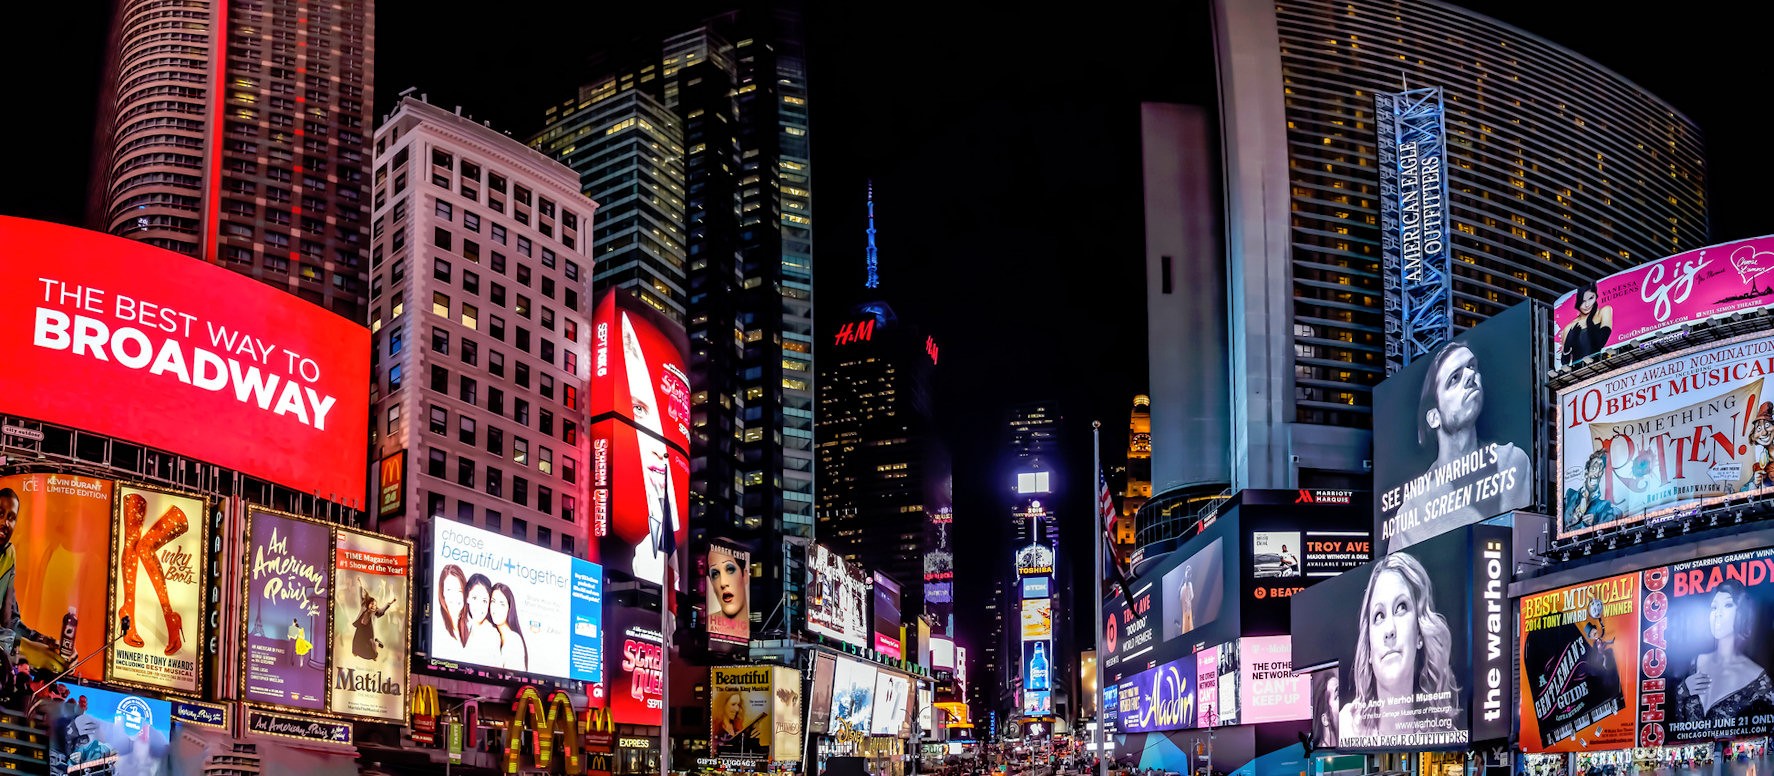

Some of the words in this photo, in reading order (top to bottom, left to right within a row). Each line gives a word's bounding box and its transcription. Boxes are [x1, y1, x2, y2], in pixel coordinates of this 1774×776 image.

[1400, 141, 1418, 189] EAGLE
[1421, 156, 1442, 255] OUTFITTERS
[1402, 191, 1421, 282] AMERICAN
[1602, 281, 1637, 296] VANESSA
[1602, 287, 1639, 304] HUDGENS
[1641, 251, 1714, 322] Gigi
[1716, 304, 1735, 312] SIMON
[1737, 300, 1762, 308] THEATRE
[38, 278, 105, 314] THE
[116, 295, 198, 338] BEST
[207, 321, 276, 364] WAY
[283, 349, 320, 383] TO
[835, 319, 875, 345] H&M
[34, 306, 337, 432] BROADWAY
[1675, 366, 1712, 378] INCLUDING
[1568, 388, 1603, 429] 10
[1606, 374, 1638, 394] TONY
[1640, 360, 1685, 384] AWARD
[1606, 384, 1662, 416] BEST
[1612, 395, 1736, 438] SOMETHING
[594, 438, 608, 486] SCREAM
[22, 480, 40, 492] ICE
[47, 478, 70, 486] KEVIN
[71, 480, 103, 491] DURANT
[1382, 487, 1400, 512] SEE
[1404, 472, 1432, 502] ANDY
[1434, 442, 1498, 488] WARHOL'S
[46, 486, 76, 495] LIMITED
[77, 490, 108, 500] EDITION
[1382, 508, 1420, 540] ACTUAL
[1424, 484, 1472, 522] SCREEN
[1476, 466, 1516, 502] TESTS
[593, 488, 608, 537] QUEENS
[267, 527, 288, 556] An
[442, 529, 484, 550] choose
[1307, 542, 1341, 552] TROY
[1346, 542, 1369, 552] AVE
[345, 552, 362, 560] TIME
[364, 554, 398, 565] Magazine's
[350, 561, 366, 570] Show
[376, 564, 386, 572] the
[387, 566, 403, 574] Year!
[1674, 563, 1691, 571] NOW
[1693, 557, 1723, 568] STARRING
[1724, 552, 1755, 563] GRAMMY
[164, 566, 197, 584] Boots
[253, 545, 325, 595] American
[1019, 566, 1052, 574] TOSHIBA
[210, 511, 222, 654] PALACE
[264, 578, 310, 609] Paris
[1139, 594, 1150, 614] AVE
[1525, 592, 1560, 619] BEST
[1562, 577, 1634, 611] MUSICAL!
[1525, 618, 1541, 632] 2014
[1542, 613, 1562, 629] TONY
[1562, 609, 1587, 625] AWARD
[1603, 601, 1633, 618] WINNER
[116, 649, 143, 662] WINNER!
[144, 654, 149, 663] 6
[168, 659, 194, 671] AWARDS
[116, 659, 144, 668] INCLUDING
[164, 667, 193, 677] MUSICAL
[842, 640, 874, 660] 1540
[876, 651, 929, 677] BROADWAY
[1640, 566, 1669, 748] CHICAGO
[335, 667, 401, 696] Matilda
[716, 670, 769, 684] Beautiful
[1253, 680, 1298, 694] CAN'T
[1535, 636, 1586, 719] GENTLEMAN'S
[1539, 674, 1547, 687] A
[1140, 666, 1194, 728] Aladdin
[1253, 694, 1282, 706] KEEP
[1286, 694, 1299, 704] UP
[1368, 700, 1385, 708] Andy
[1387, 694, 1414, 705] Warhol
[1416, 691, 1451, 702] Museum
[1484, 667, 1501, 721] the
[1557, 682, 1589, 709] GUIDE
[255, 717, 267, 729] An
[269, 718, 306, 736] American
[308, 724, 328, 739] Paris
[1395, 718, 1452, 729] www.warhol.org
[1669, 719, 1711, 732] THROUGH
[1713, 718, 1736, 728] JUNE
[1738, 716, 1748, 725] 21
[1677, 726, 1767, 740] CHICAGOTHEMUSICAL.COM
[620, 738, 649, 748] EXPRESS
[1340, 736, 1379, 747] AMERICAN
[1381, 734, 1407, 746] EAGLE
[1408, 730, 1468, 745] OUTFITTERS
[1592, 751, 1632, 764] GRAND
[1657, 746, 1694, 761] SLAM
